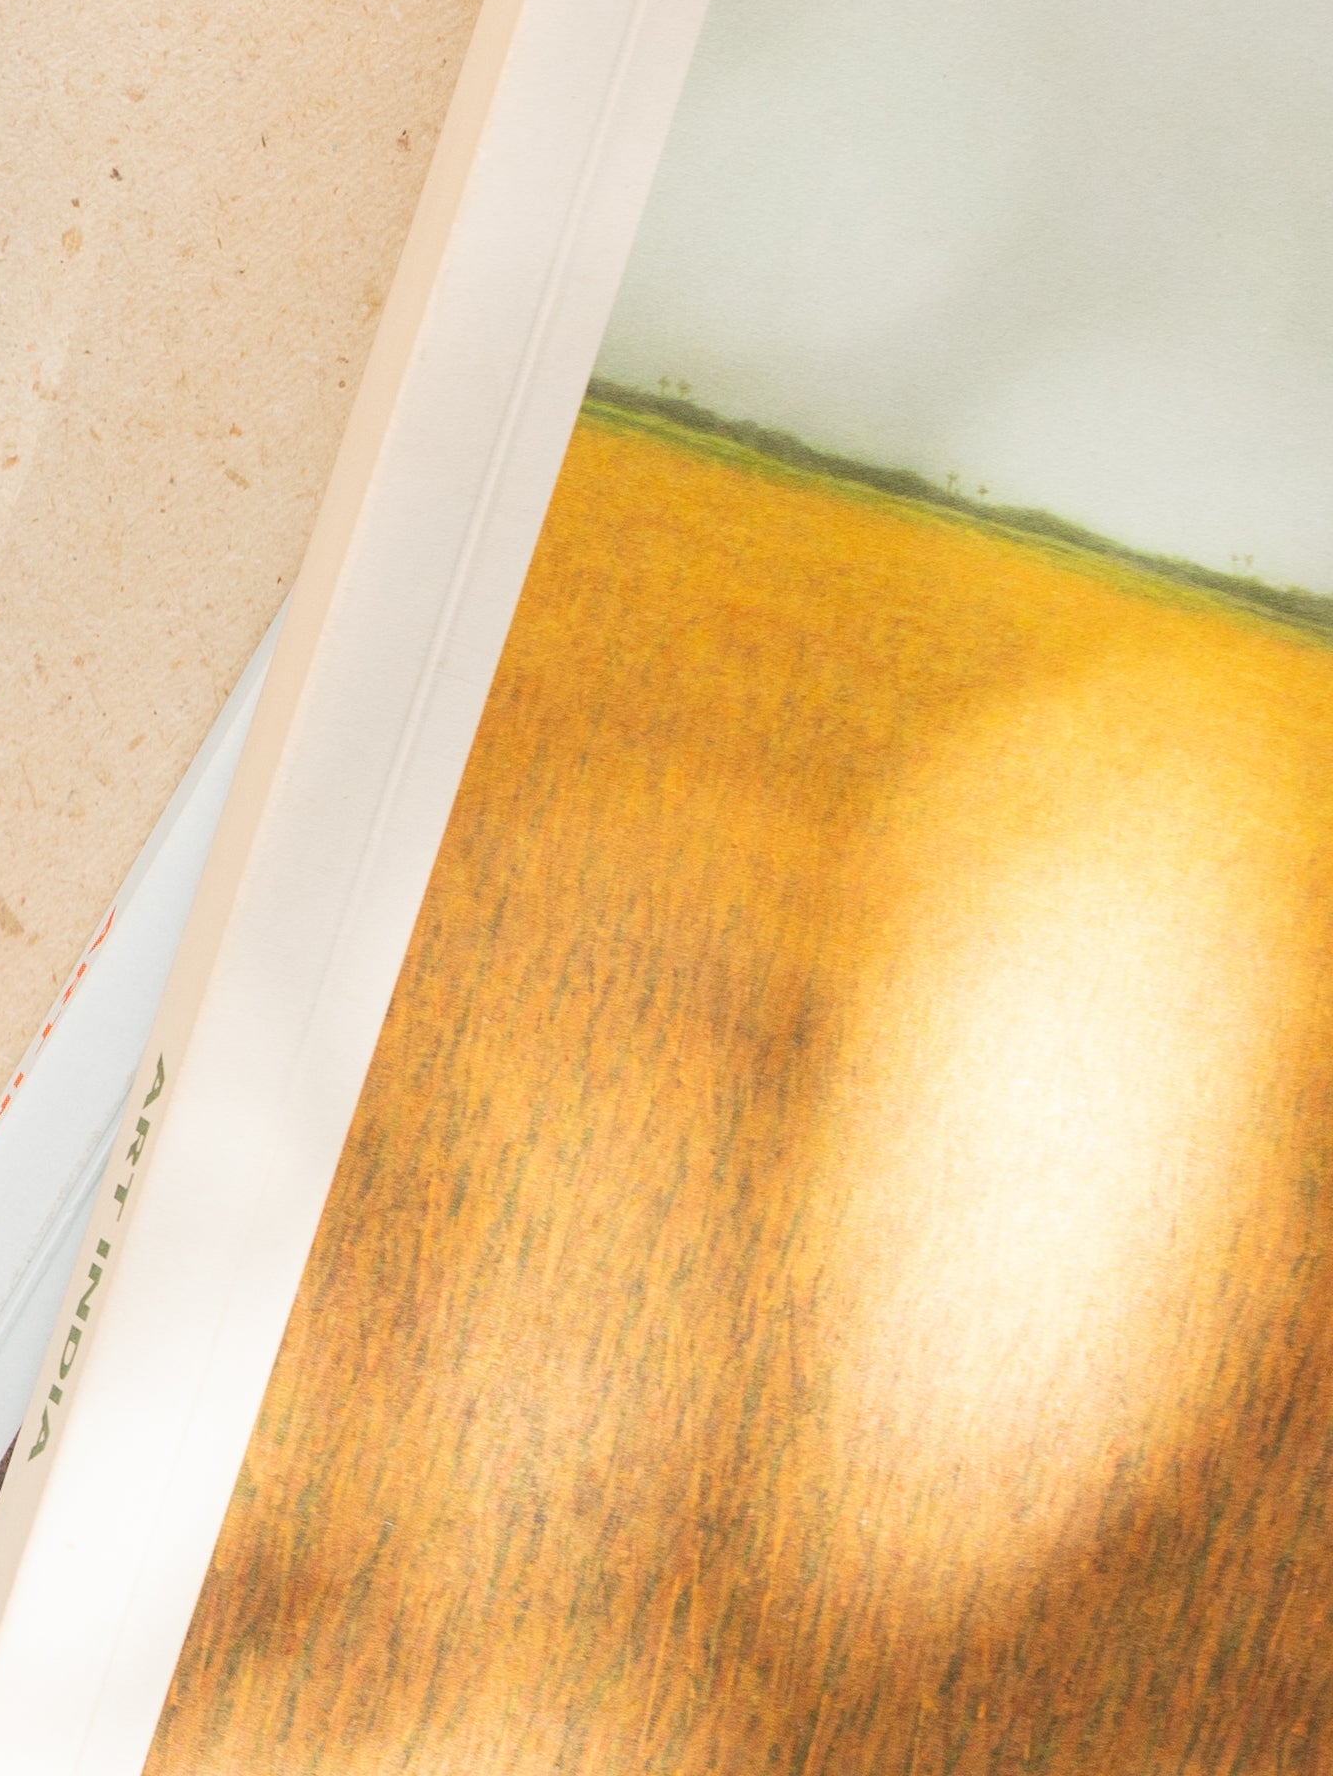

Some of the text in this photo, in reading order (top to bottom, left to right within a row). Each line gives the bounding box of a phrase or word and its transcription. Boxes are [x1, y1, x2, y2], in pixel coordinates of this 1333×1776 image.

[36, 905, 117, 1053] ART
[27, 1052, 165, 1463] ART INDIA
